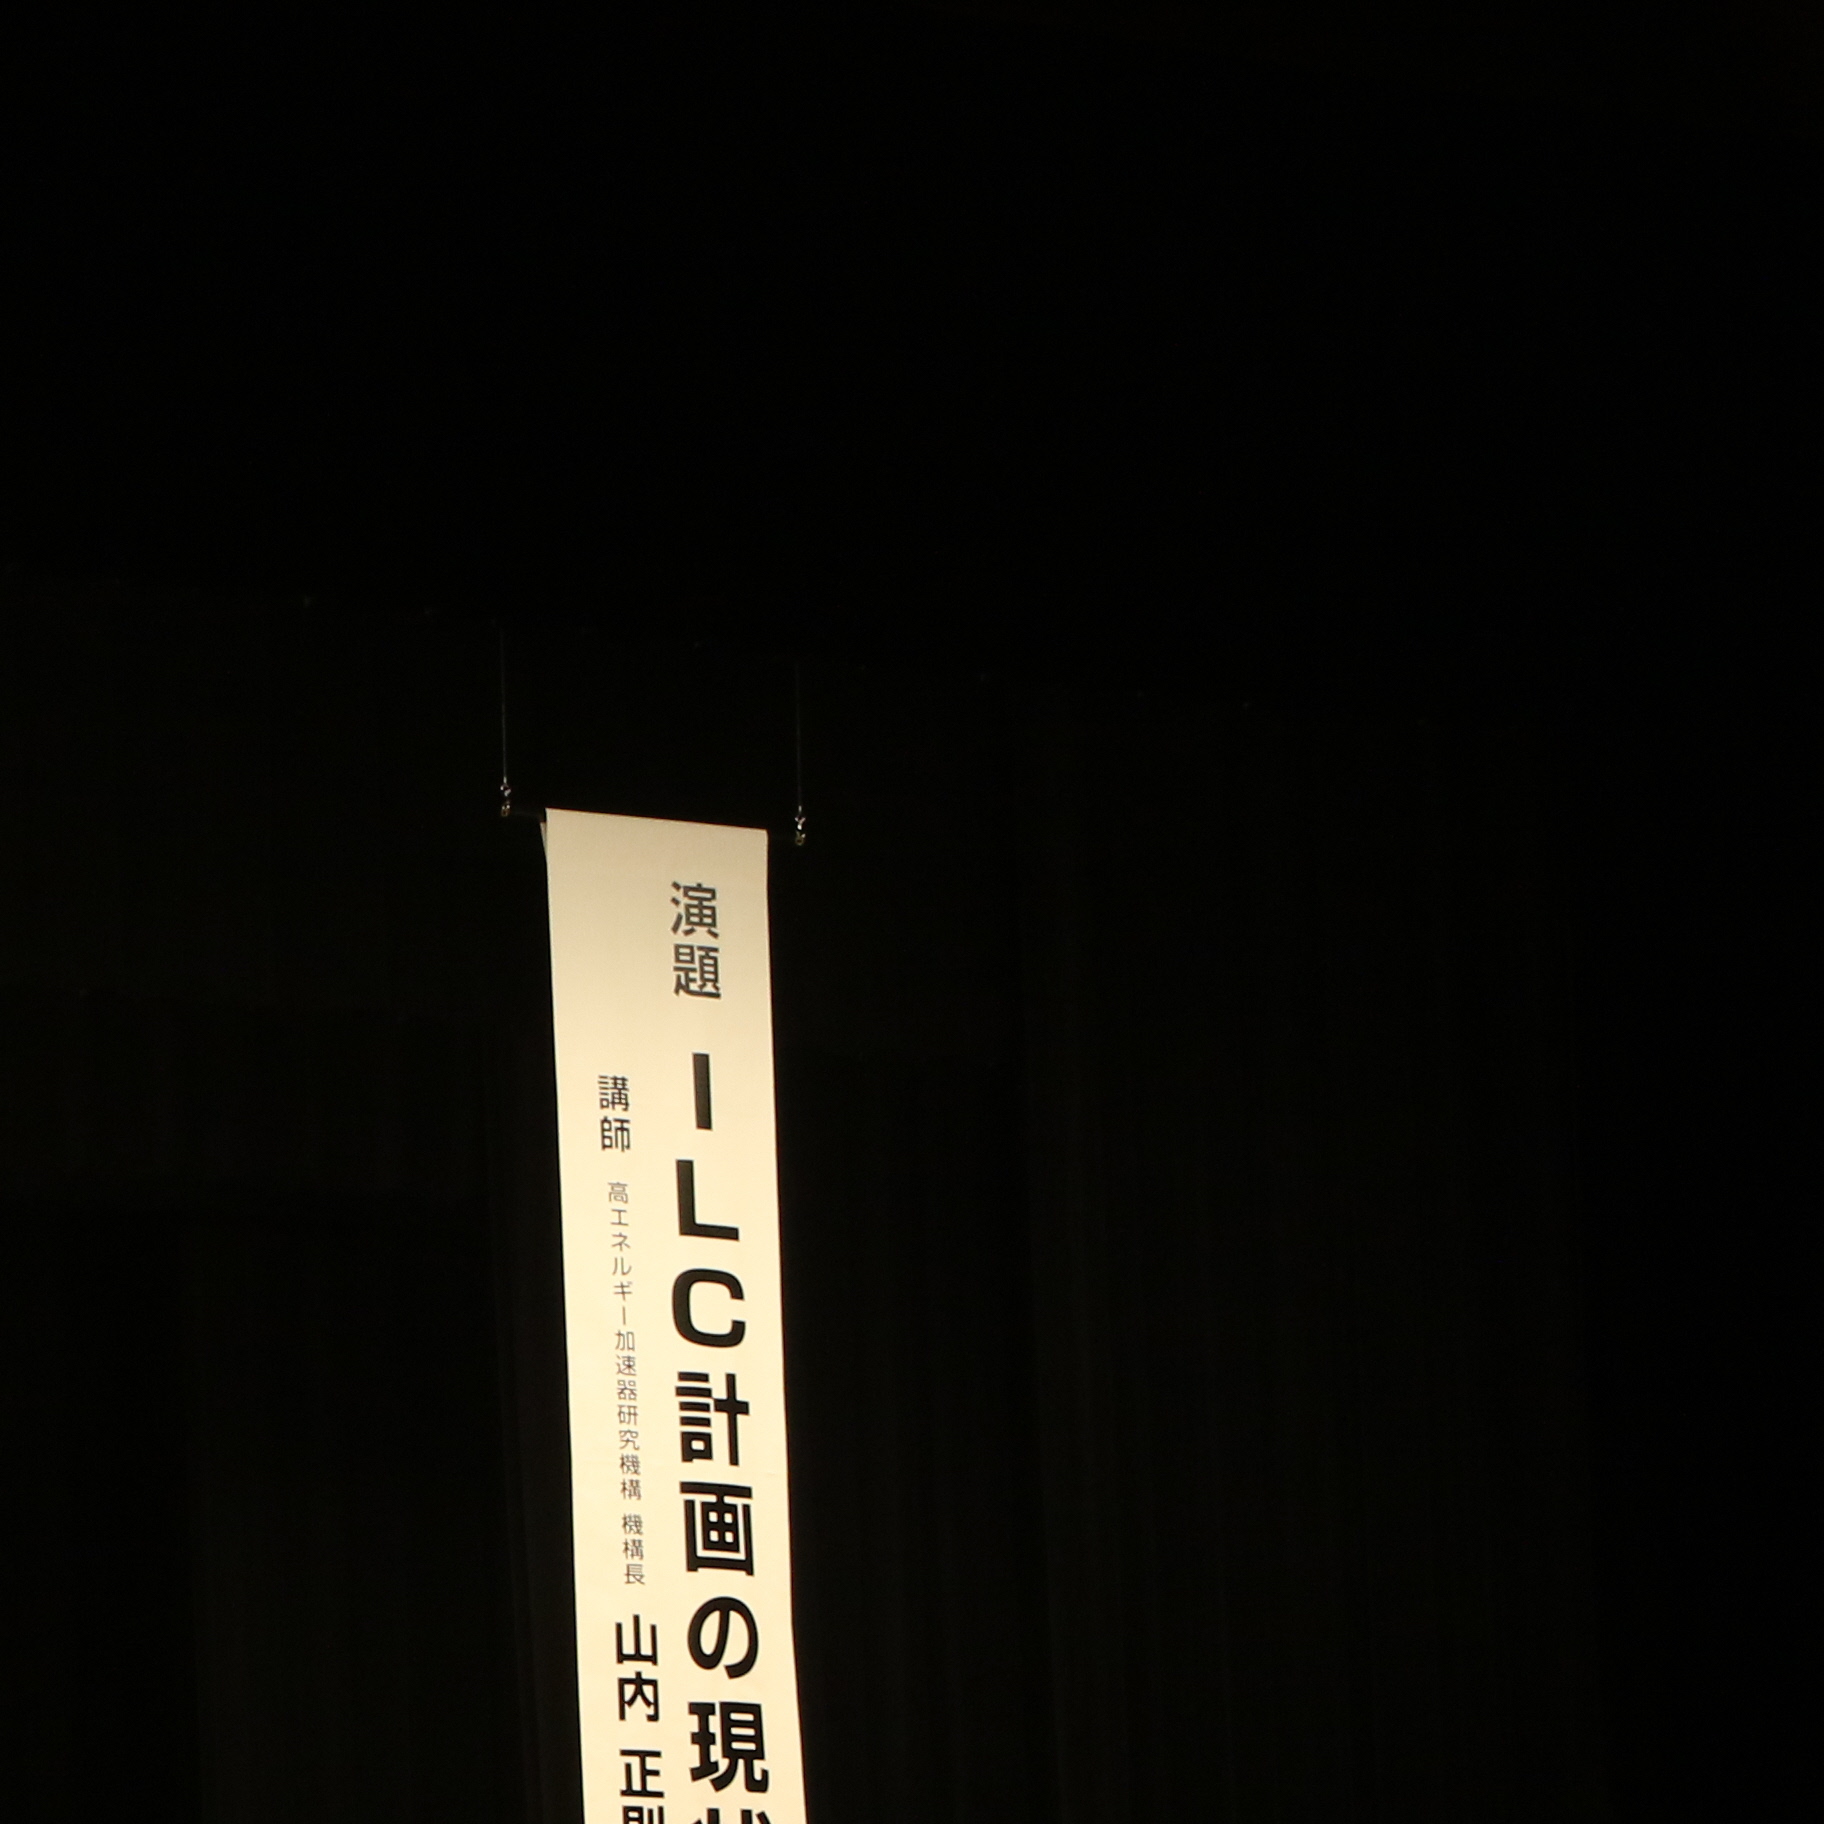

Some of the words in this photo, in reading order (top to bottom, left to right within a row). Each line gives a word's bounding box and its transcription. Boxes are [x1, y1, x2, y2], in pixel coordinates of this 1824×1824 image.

[670, 880, 722, 1000] 演題
[597, 1075, 632, 1153] 講師
[607, 1180, 643, 1501] 高エネルギー加速器研究機構
[619, 1513, 646, 1586] 機構長
